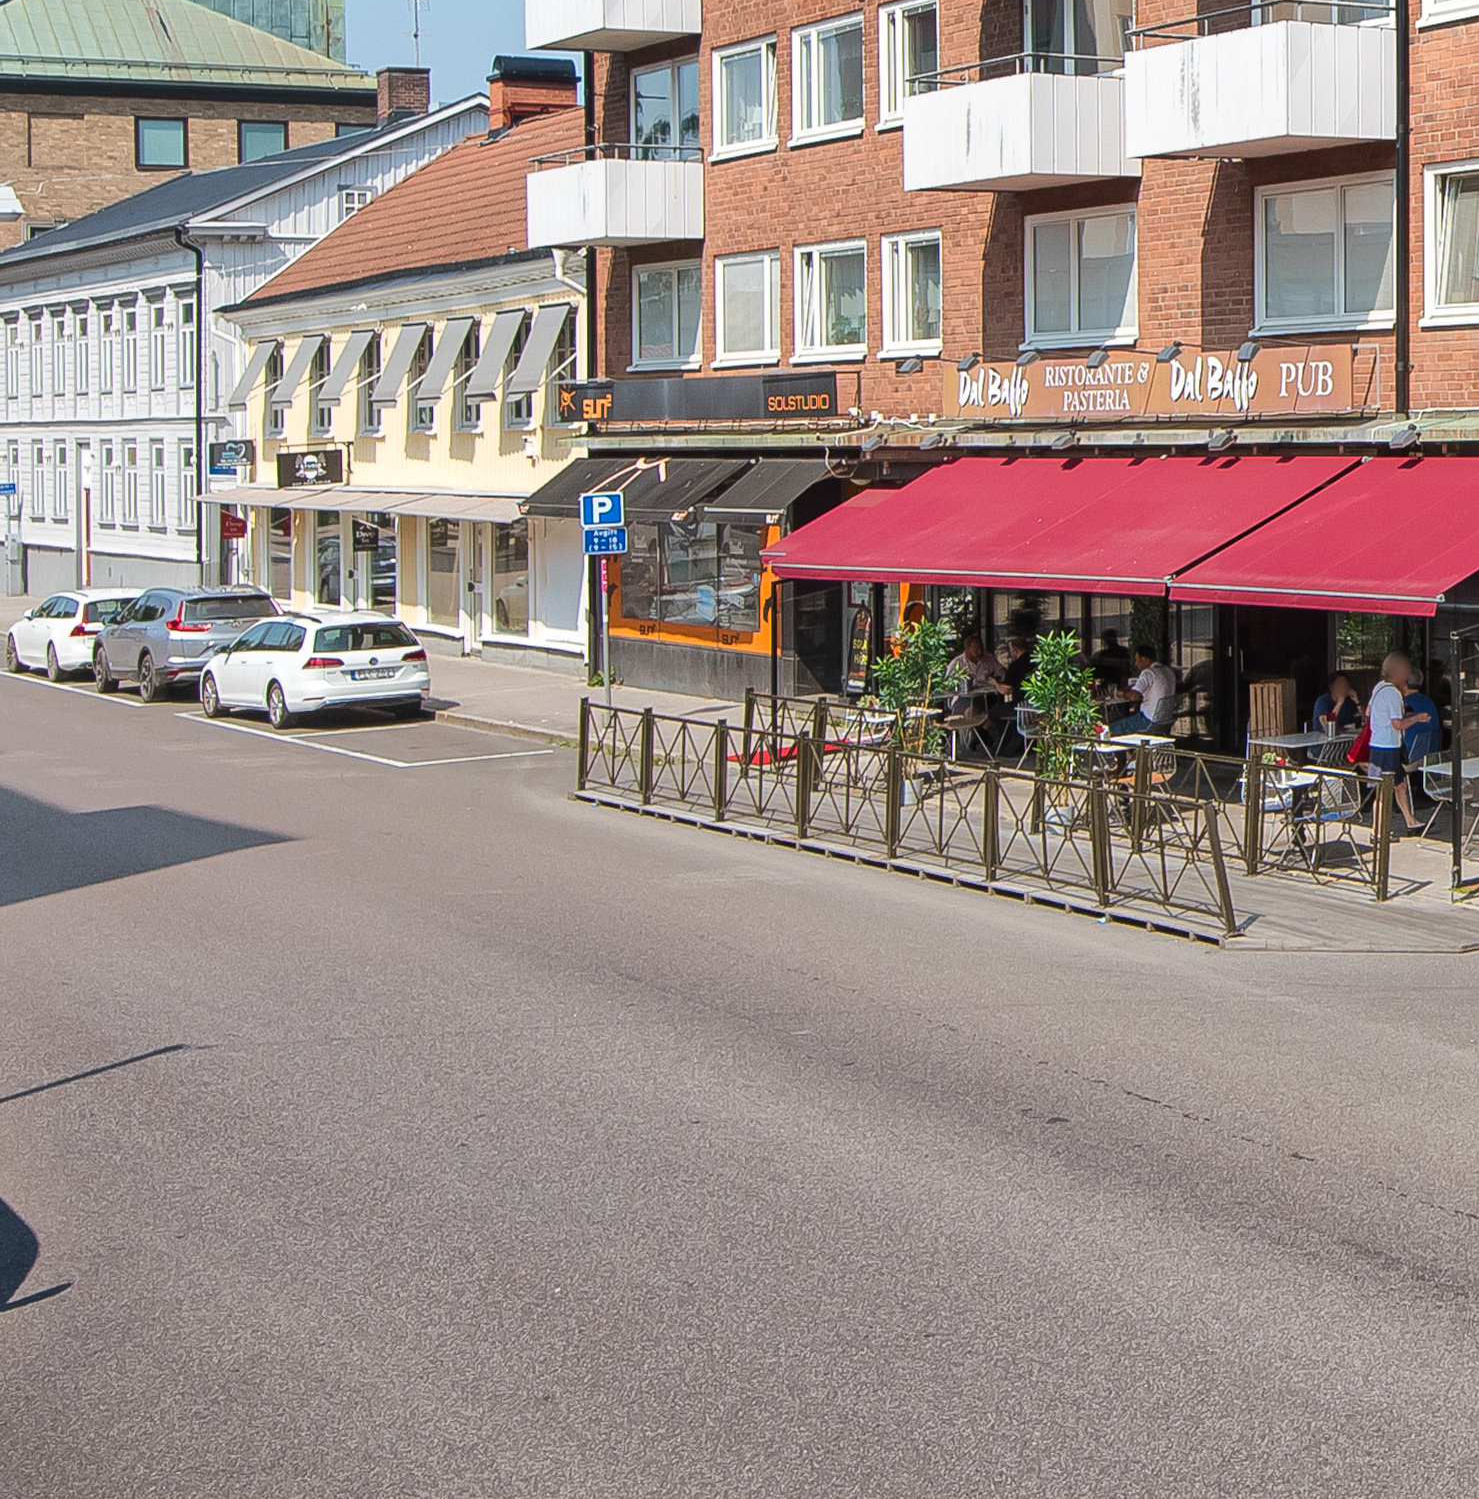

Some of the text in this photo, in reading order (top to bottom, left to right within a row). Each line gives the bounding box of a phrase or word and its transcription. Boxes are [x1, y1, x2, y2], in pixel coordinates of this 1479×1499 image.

[1044, 362, 1134, 387] RISTORANTE
[1170, 355, 1258, 411] Dal Baffo
[1279, 361, 1333, 397] PUB
[767, 394, 830, 411] SOLSTUDIO
[958, 365, 1030, 416] Dal Baffo
[1063, 389, 1131, 411] PASTERIA
[592, 496, 613, 523] P
